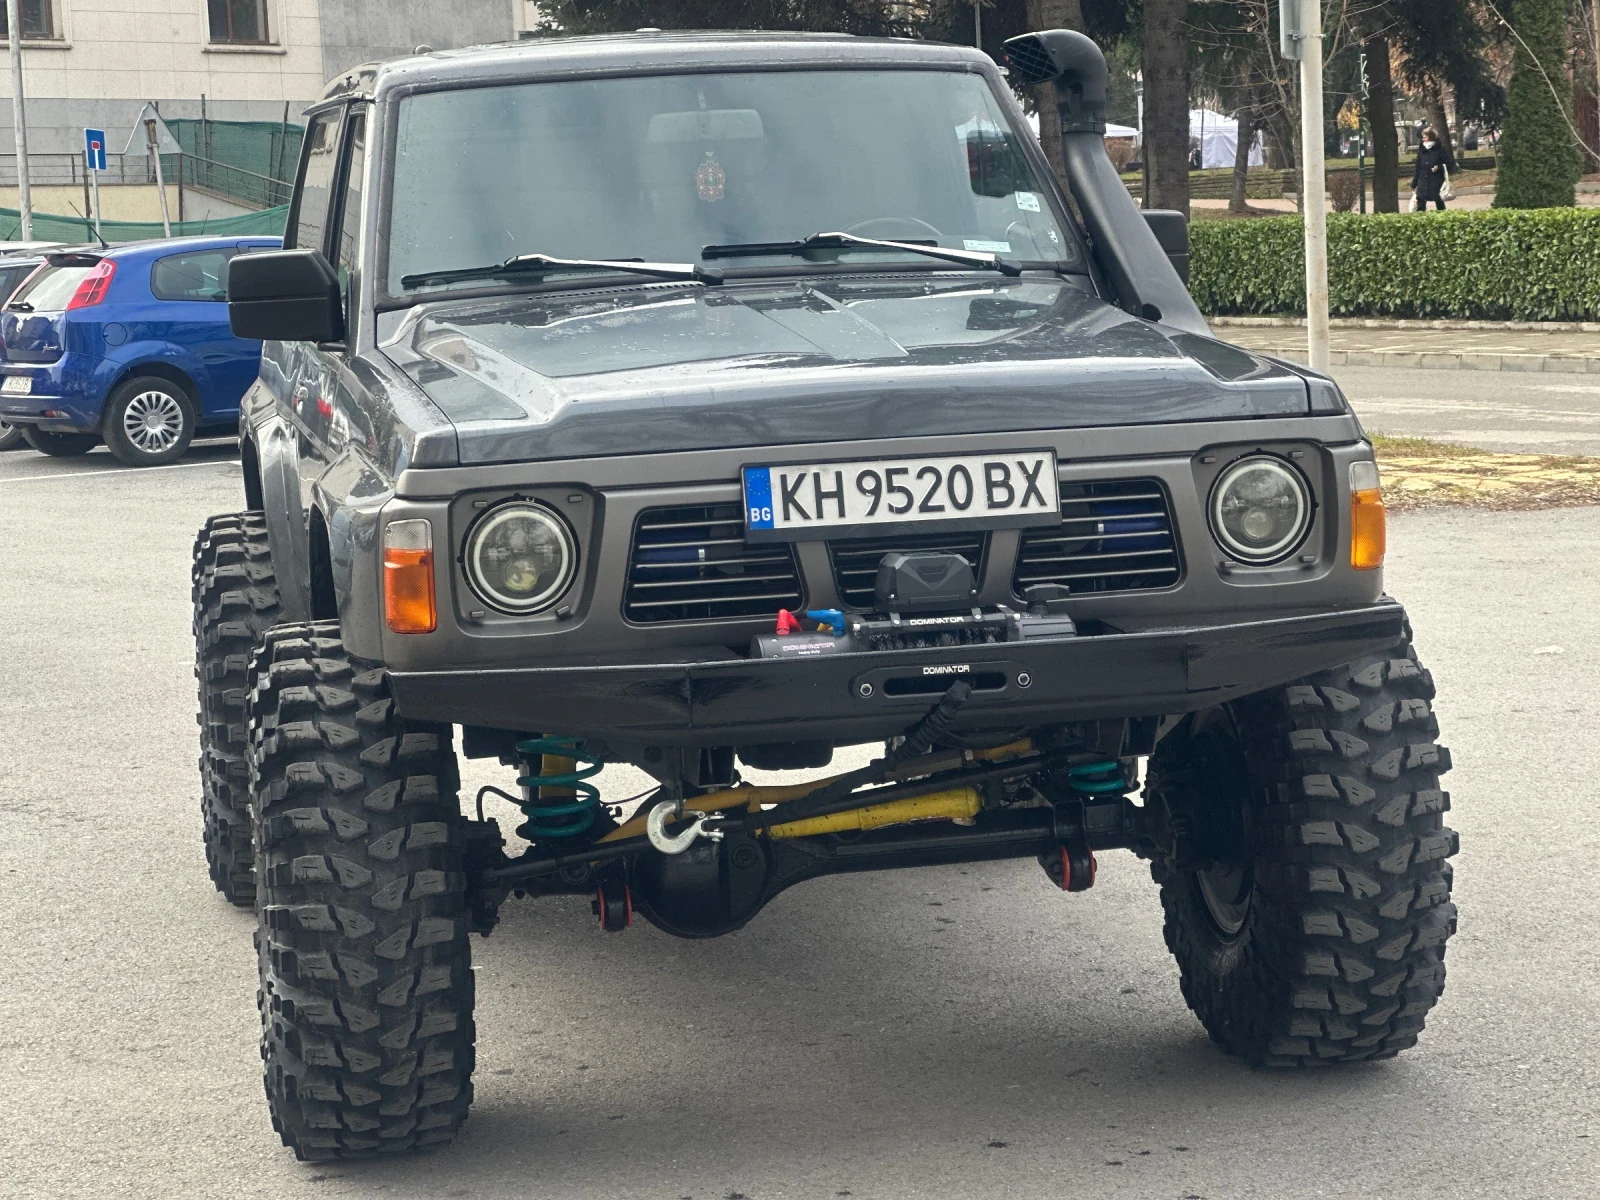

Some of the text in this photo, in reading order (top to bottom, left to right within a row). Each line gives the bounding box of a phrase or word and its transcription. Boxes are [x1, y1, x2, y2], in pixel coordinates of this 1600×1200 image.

[856, 465, 974, 517] 9520
[750, 508, 771, 522] BG
[910, 617, 964, 626] DOMINATOR
[782, 642, 835, 651] DOMINATOR
[923, 665, 970, 675] DOMINATOR
